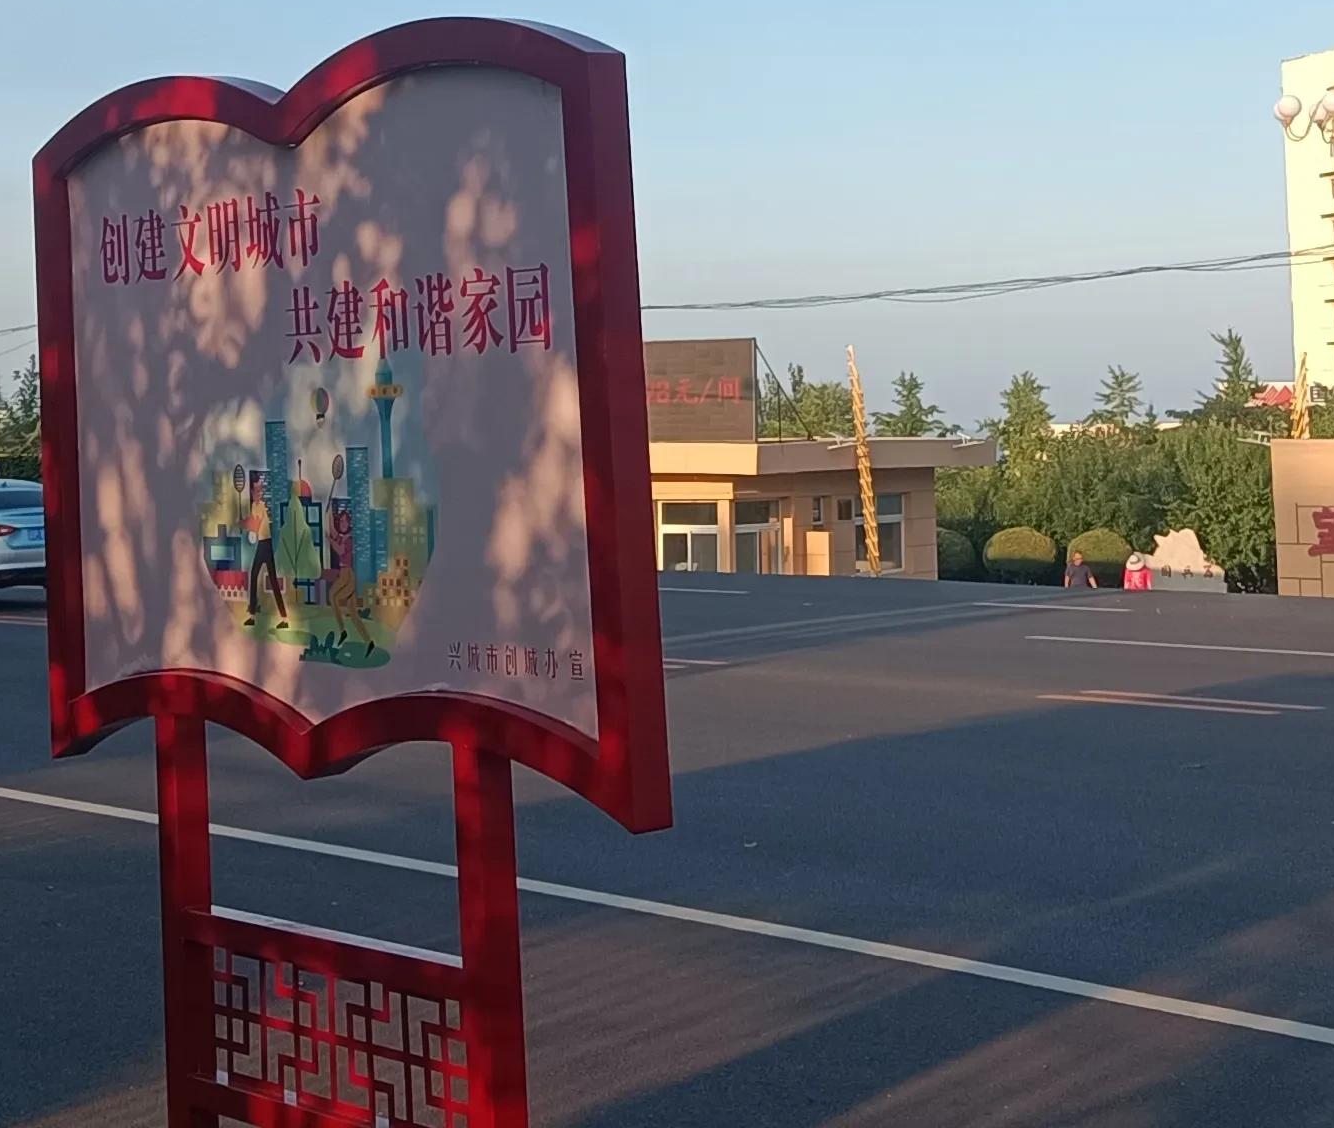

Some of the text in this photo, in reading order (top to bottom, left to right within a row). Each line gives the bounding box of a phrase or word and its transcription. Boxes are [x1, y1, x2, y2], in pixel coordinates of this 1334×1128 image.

[100, 188, 321, 285] 创建文明城市
[284, 262, 551, 365] 共建和谐家园
